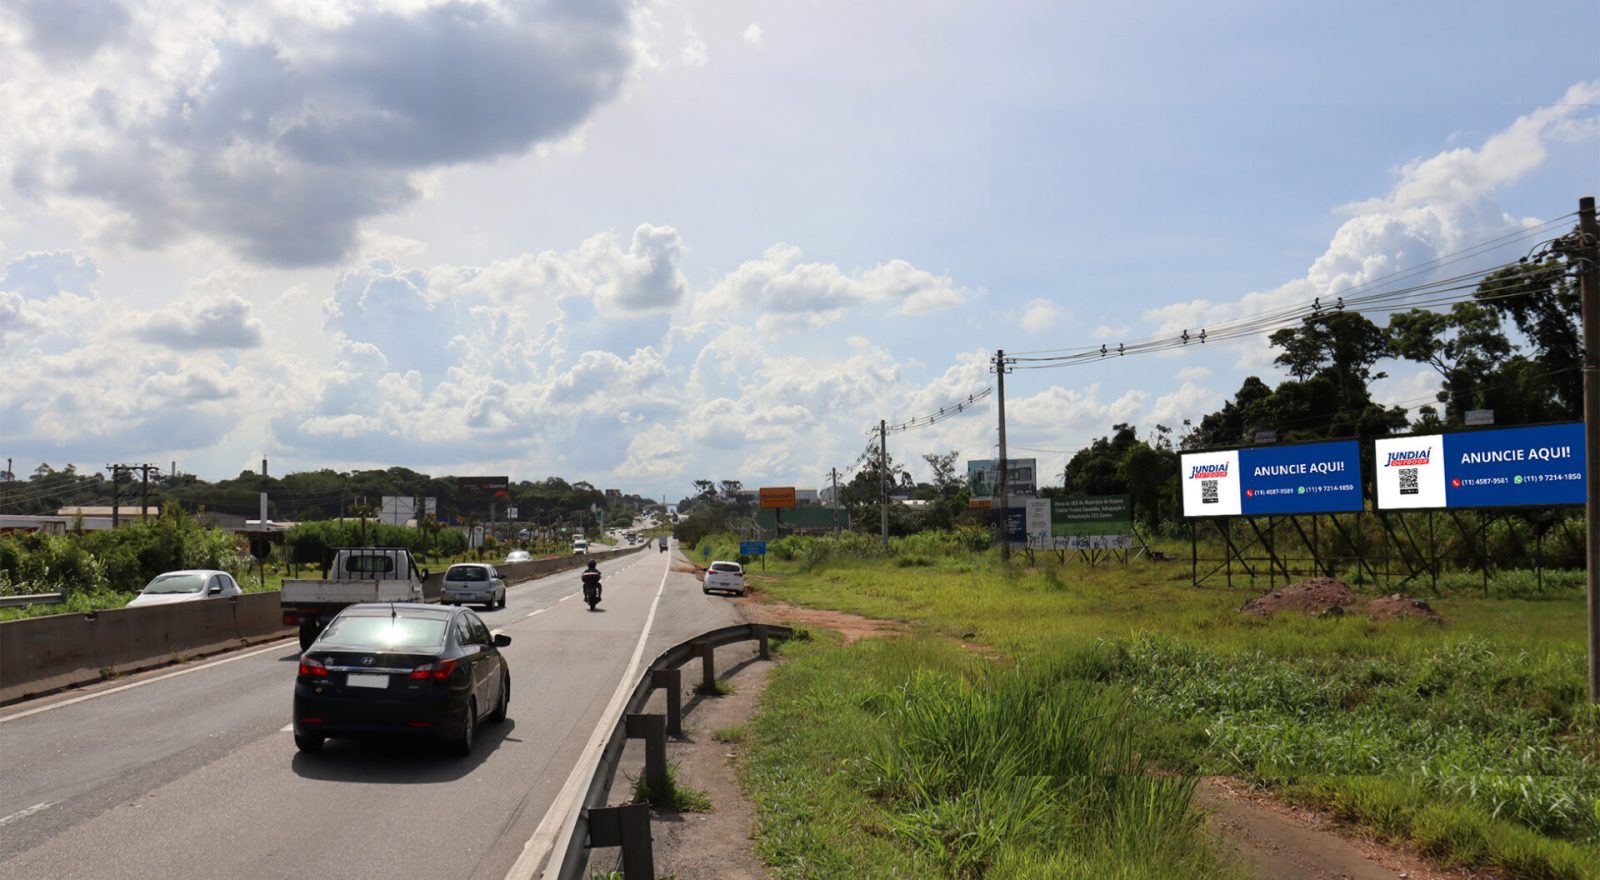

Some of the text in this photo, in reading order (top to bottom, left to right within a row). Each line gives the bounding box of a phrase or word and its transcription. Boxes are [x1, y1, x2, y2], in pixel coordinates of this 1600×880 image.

[1384, 447, 1432, 467] JUNDIAÍ
[1461, 446, 1571, 464] ANUNCIE AQUI!
[1391, 458, 1429, 466] OUTDOOR
[1254, 461, 1345, 477] ANUNCIE AQUI!
[1461, 479, 1474, 487] (11)
[1524, 475, 1537, 483] (11)
